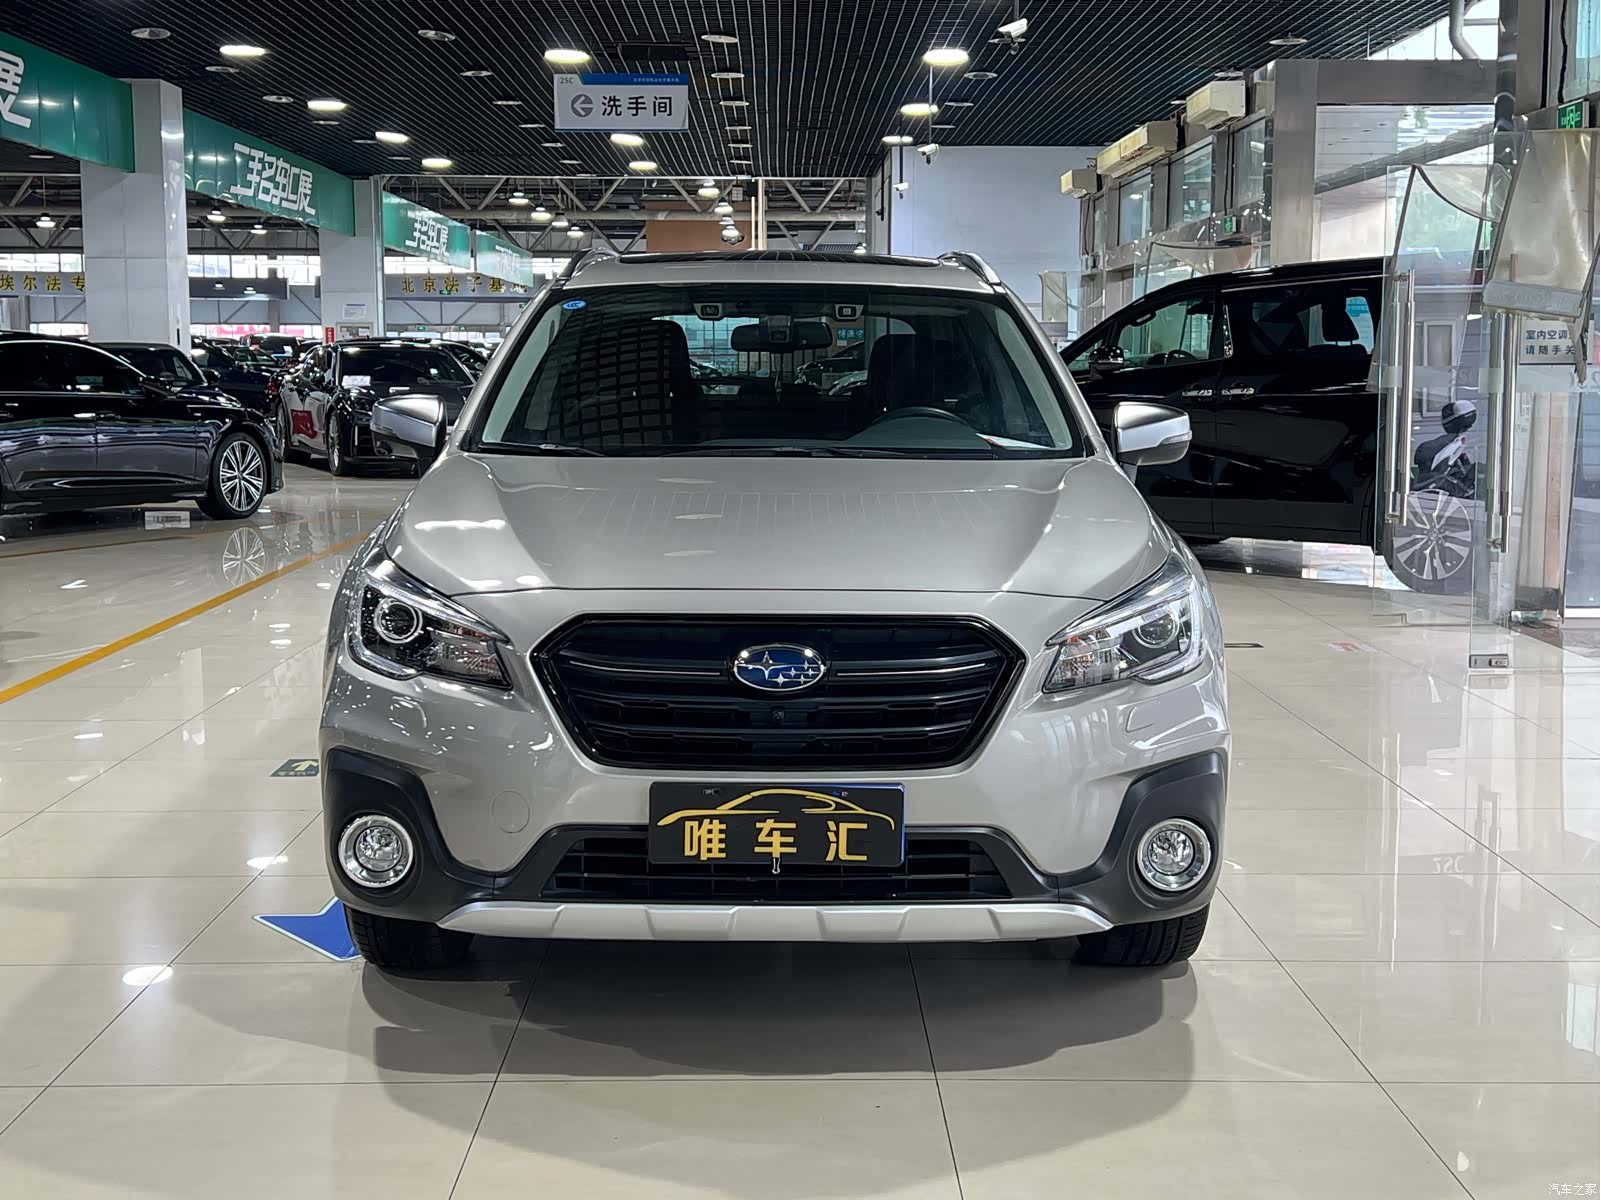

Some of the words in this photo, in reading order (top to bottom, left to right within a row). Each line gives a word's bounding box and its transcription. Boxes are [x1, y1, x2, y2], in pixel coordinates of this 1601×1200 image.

[601, 96, 672, 117] 洗手间
[230, 142, 316, 215] 二手名车汇展
[0, 274, 85, 292] 埃尔法专
[1526, 330, 1568, 340] 室内空调
[1526, 345, 1575, 355] 请随手关
[684, 818, 868, 861] 唯车汇
